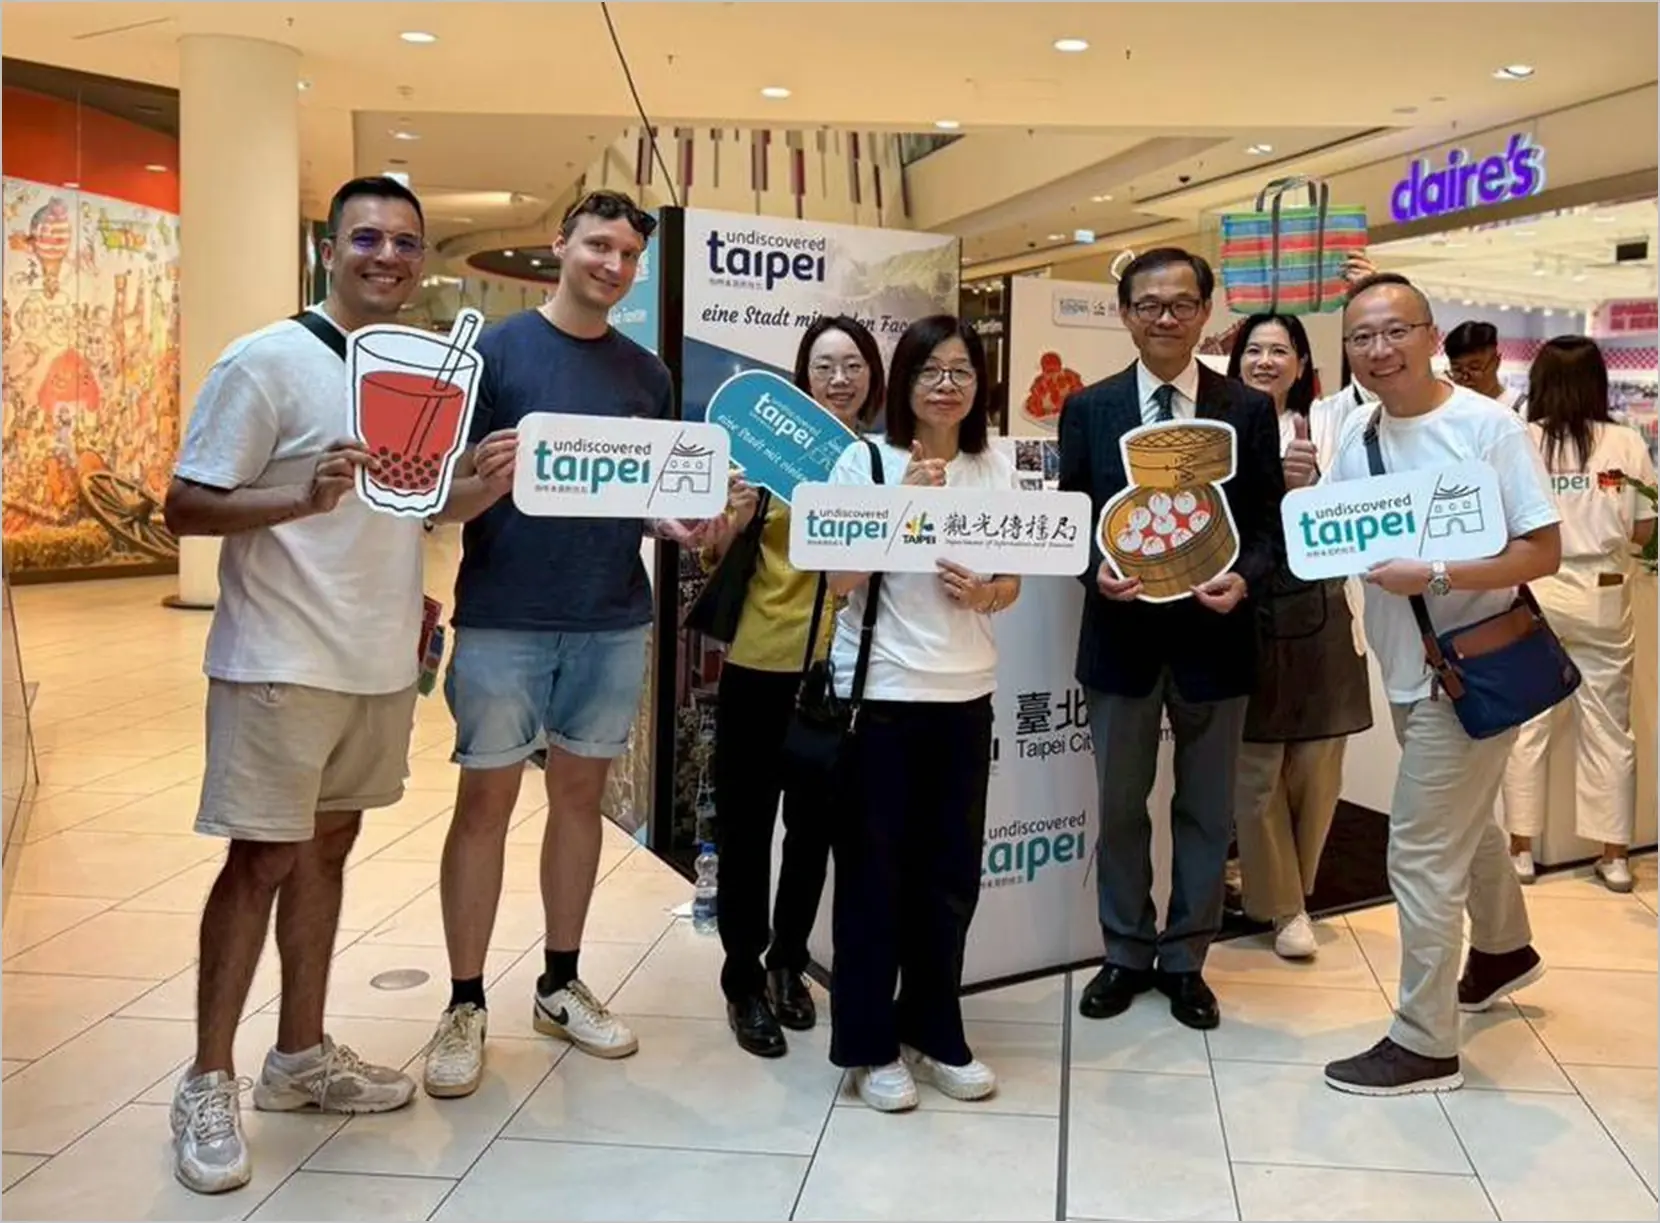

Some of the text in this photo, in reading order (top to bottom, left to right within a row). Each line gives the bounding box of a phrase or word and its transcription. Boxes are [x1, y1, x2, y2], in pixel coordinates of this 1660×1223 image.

[1391, 134, 1541, 222] claire's
[726, 231, 826, 251] undiscovered
[707, 230, 825, 291] taipei
[702, 304, 740, 324] eine
[744, 305, 790, 327] Stadt
[881, 315, 909, 332] Fac
[753, 392, 815, 450] taipei
[554, 438, 652, 455] undiscovered
[534, 440, 650, 494] taipei
[1551, 475, 1590, 494] ipei
[819, 508, 889, 519] undiscovered
[1315, 494, 1412, 519] undiscovered
[807, 510, 888, 546] taipei
[902, 534, 936, 545] TAIPEI
[942, 511, 1078, 541] 觀光傳播局
[1299, 510, 1416, 551] taipei
[1016, 737, 1066, 761] Taipei
[988, 810, 1086, 841] undiscovered
[981, 831, 1085, 882] aipei
